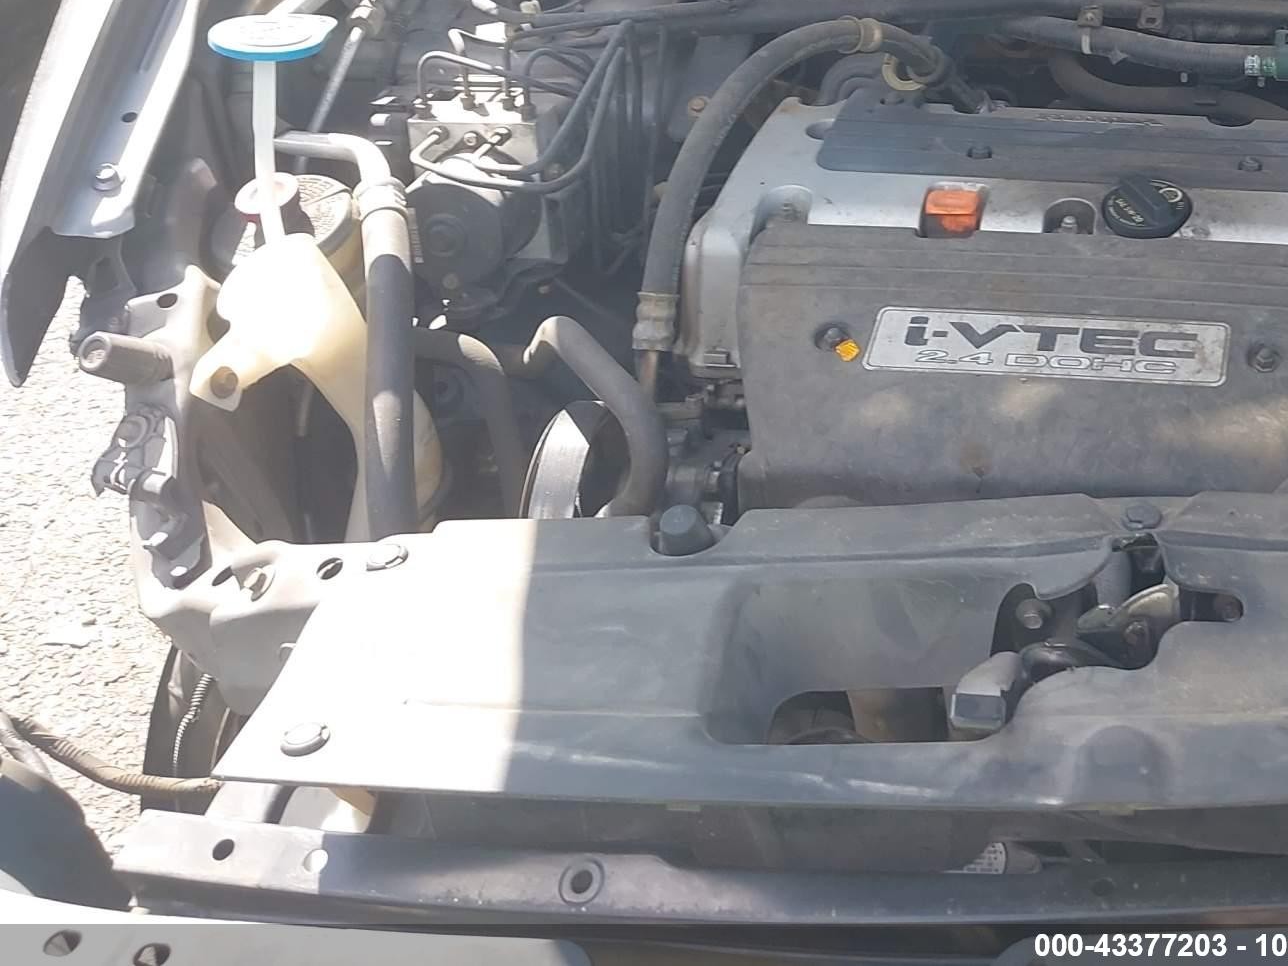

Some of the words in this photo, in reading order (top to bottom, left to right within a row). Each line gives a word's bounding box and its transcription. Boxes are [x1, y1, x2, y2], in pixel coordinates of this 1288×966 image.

[904, 315, 1199, 360] i-VTEC
[914, 349, 994, 366] 2.4
[1003, 352, 1178, 376] DOHC
